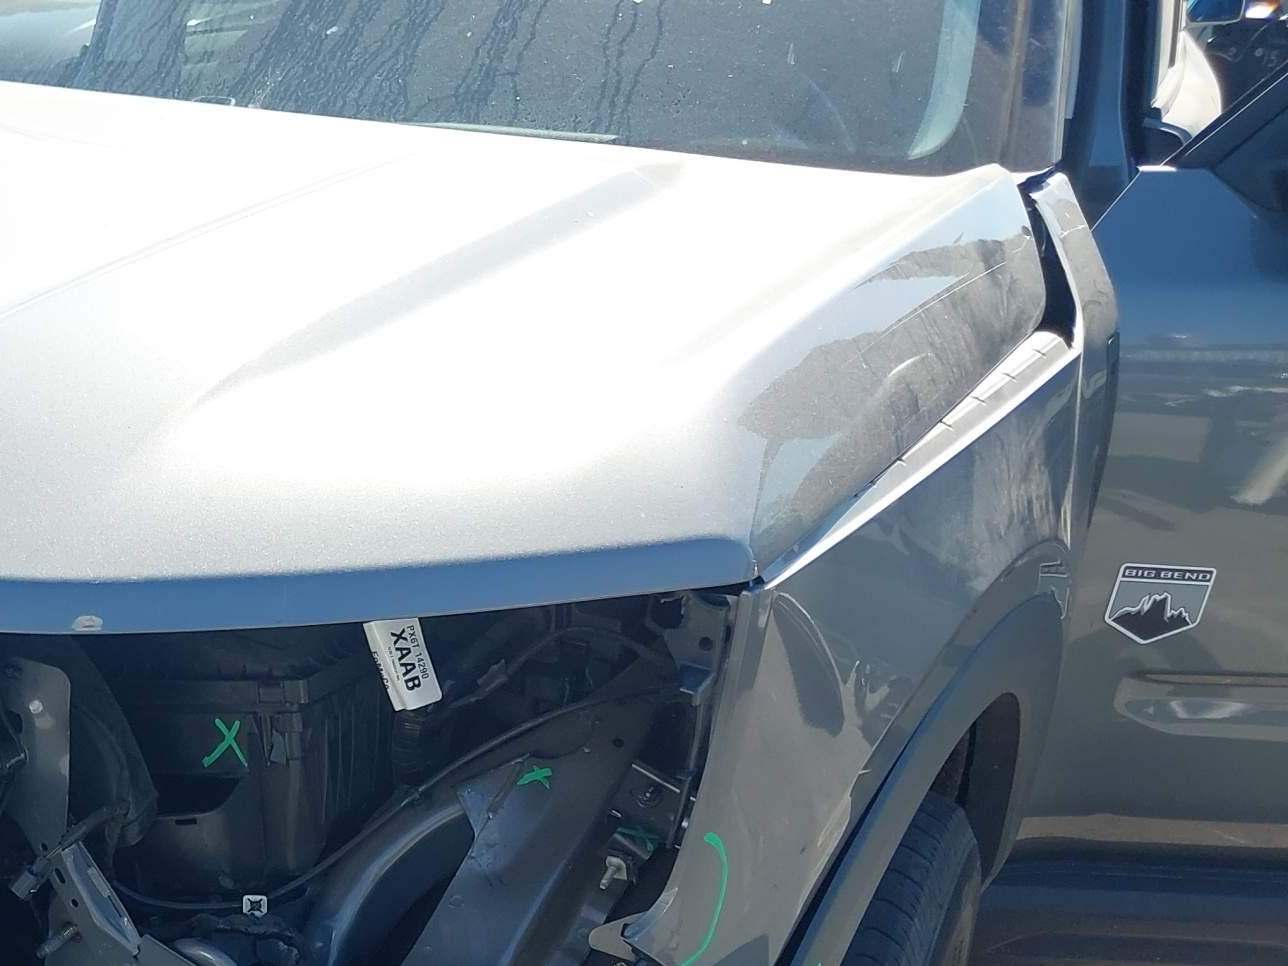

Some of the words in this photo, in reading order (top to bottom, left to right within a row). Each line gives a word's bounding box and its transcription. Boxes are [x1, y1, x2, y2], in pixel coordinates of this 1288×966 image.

[1124, 568, 1156, 578] BIG
[1160, 571, 1211, 581] BEND
[390, 627, 422, 691] XAAB
[415, 652, 430, 680] 14290
